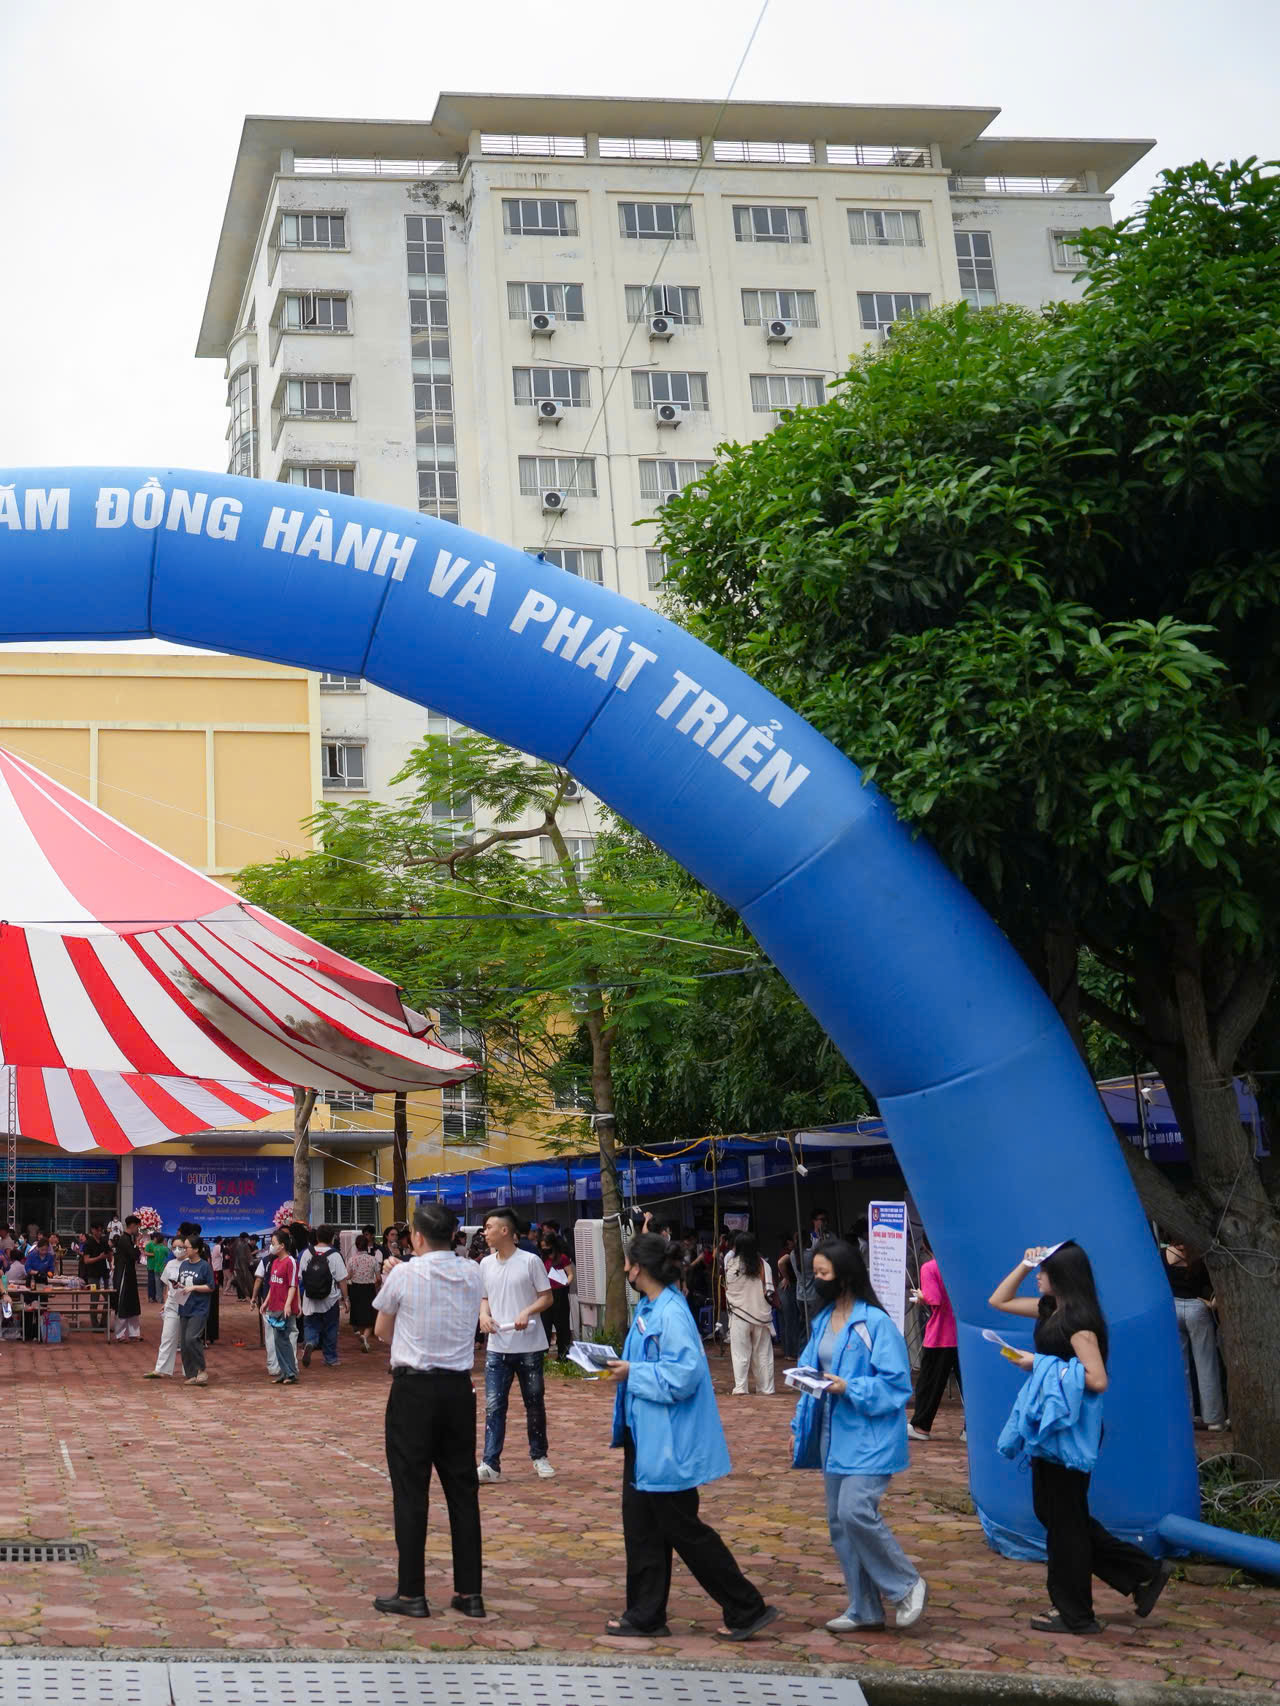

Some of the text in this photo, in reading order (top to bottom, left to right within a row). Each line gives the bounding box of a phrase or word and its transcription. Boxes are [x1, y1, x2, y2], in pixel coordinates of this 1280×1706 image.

[95, 476, 243, 542] ĐỒNG
[262, 509, 417, 582] HÀNH
[428, 549, 497, 617] VÀ
[509, 589, 658, 692] PHÁT
[655, 670, 811, 808] TRIỂN
[187, 1173, 216, 1185] HITU
[197, 1185, 214, 1193] JOB
[217, 1180, 256, 1196] FAIR
[217, 1196, 240, 1205] 2026
